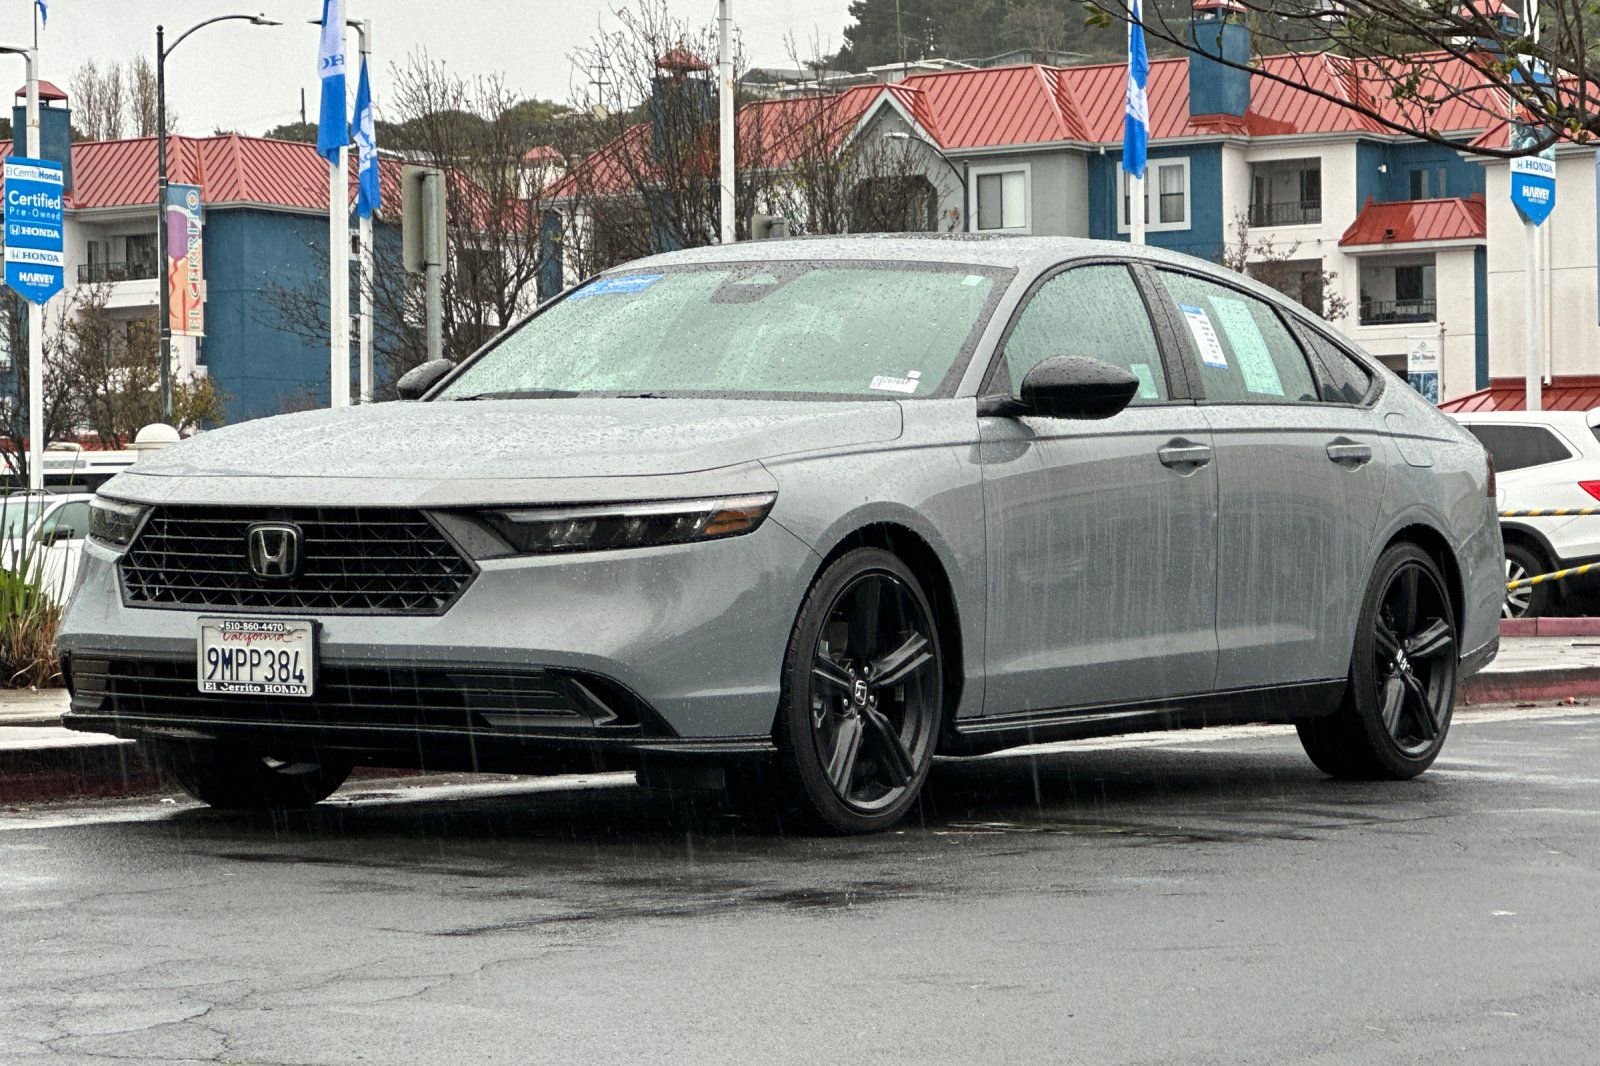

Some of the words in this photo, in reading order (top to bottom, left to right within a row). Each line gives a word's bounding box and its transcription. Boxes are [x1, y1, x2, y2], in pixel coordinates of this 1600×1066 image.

[1525, 160, 1553, 173] HONDA
[8, 190, 61, 210] Certified
[1522, 185, 1550, 201] HARVEY
[9, 206, 61, 221] Pre-Owned
[20, 226, 60, 239] HONDA
[186, 189, 200, 299] CERRITO
[22, 250, 59, 262] HONDA
[19, 271, 55, 284] HARVEY
[189, 308, 201, 330] EL
[225, 621, 285, 632] 510-860-4470
[222, 631, 292, 646] California
[207, 647, 305, 684] 9MPP384
[205, 682, 216, 691] El
[220, 683, 261, 693] Cerrito
[264, 684, 306, 694] HONDA
